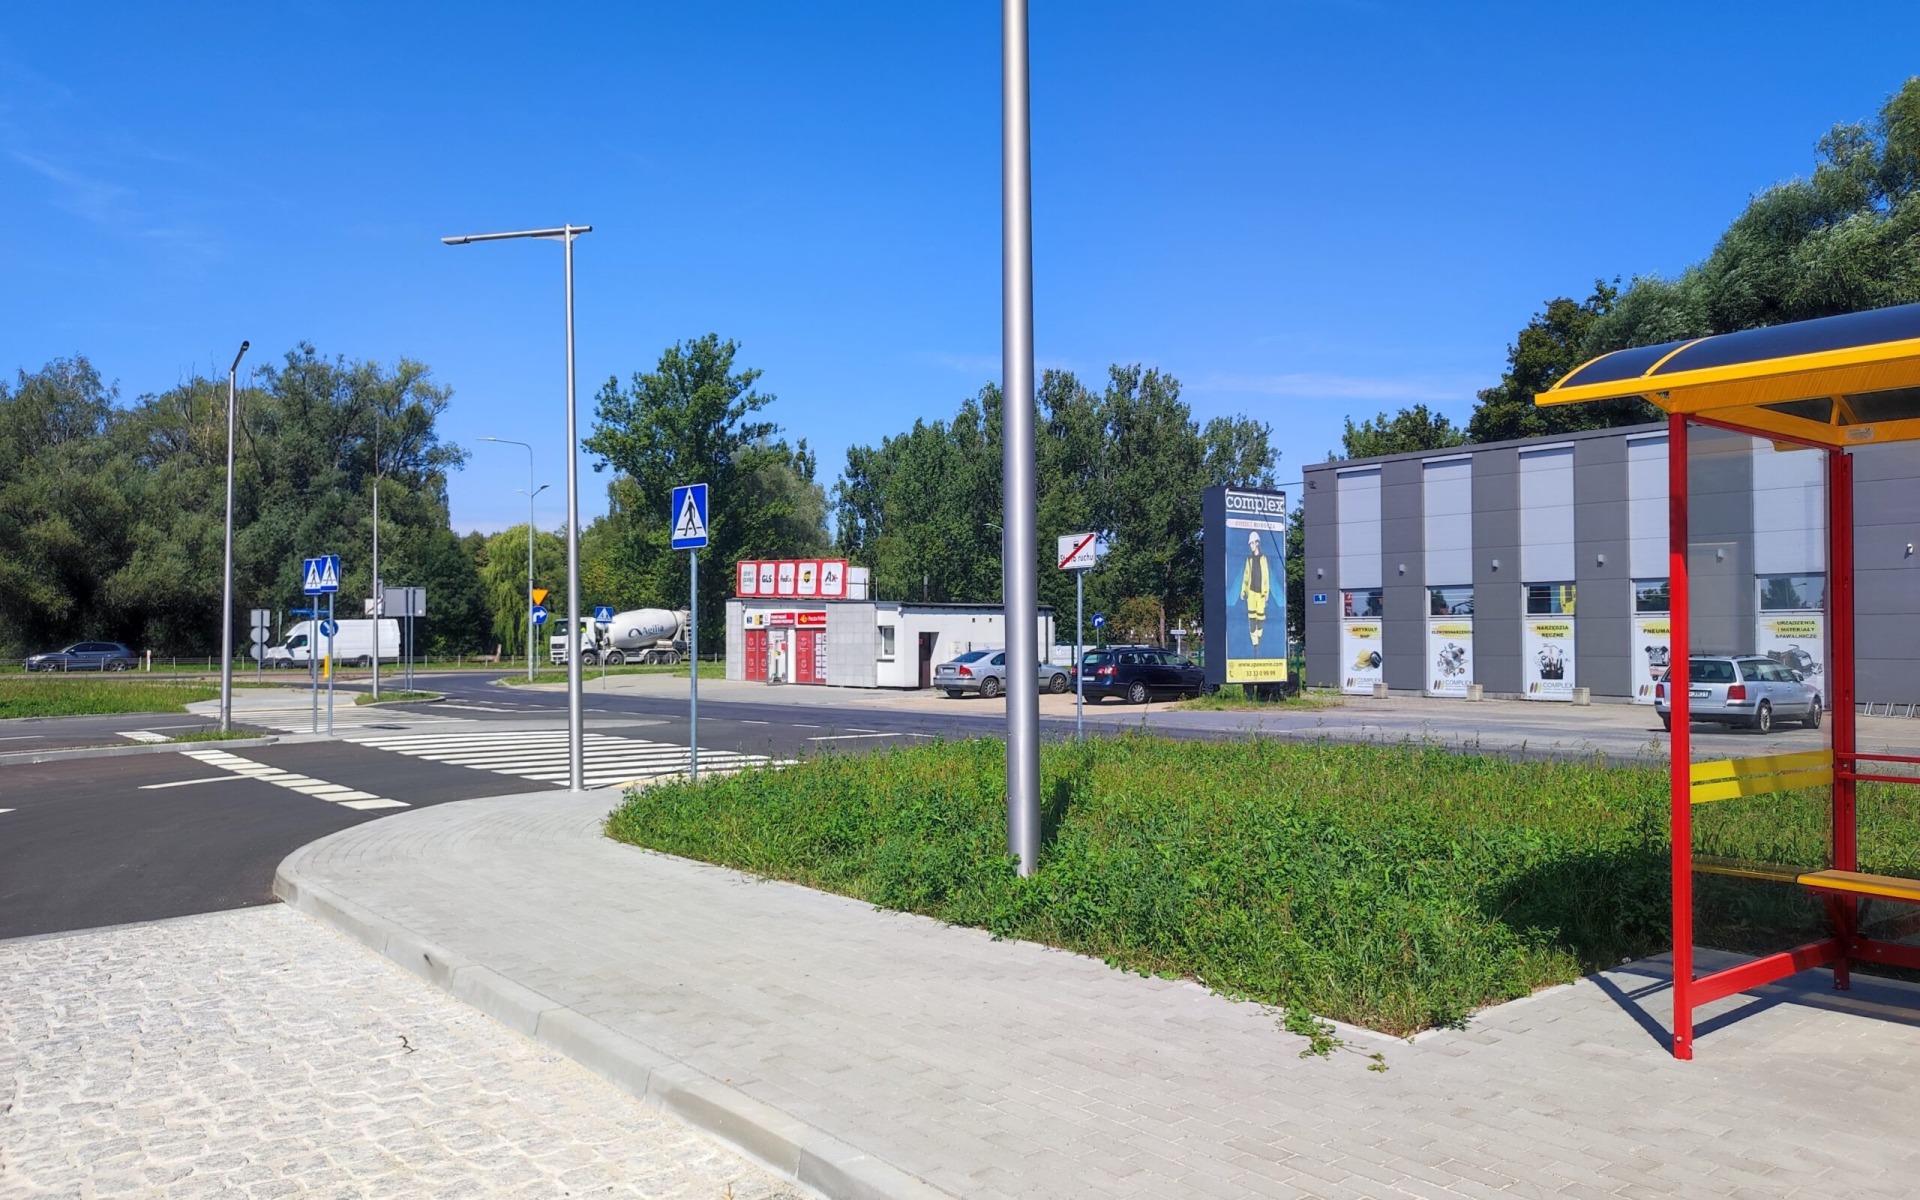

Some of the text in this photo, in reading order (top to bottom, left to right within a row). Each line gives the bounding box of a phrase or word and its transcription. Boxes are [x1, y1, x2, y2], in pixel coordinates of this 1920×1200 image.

[1226, 495, 1284, 514] complex
[1078, 552, 1094, 562] ruchu
[761, 574, 773, 583] GLS
[642, 624, 664, 635] Agilia
